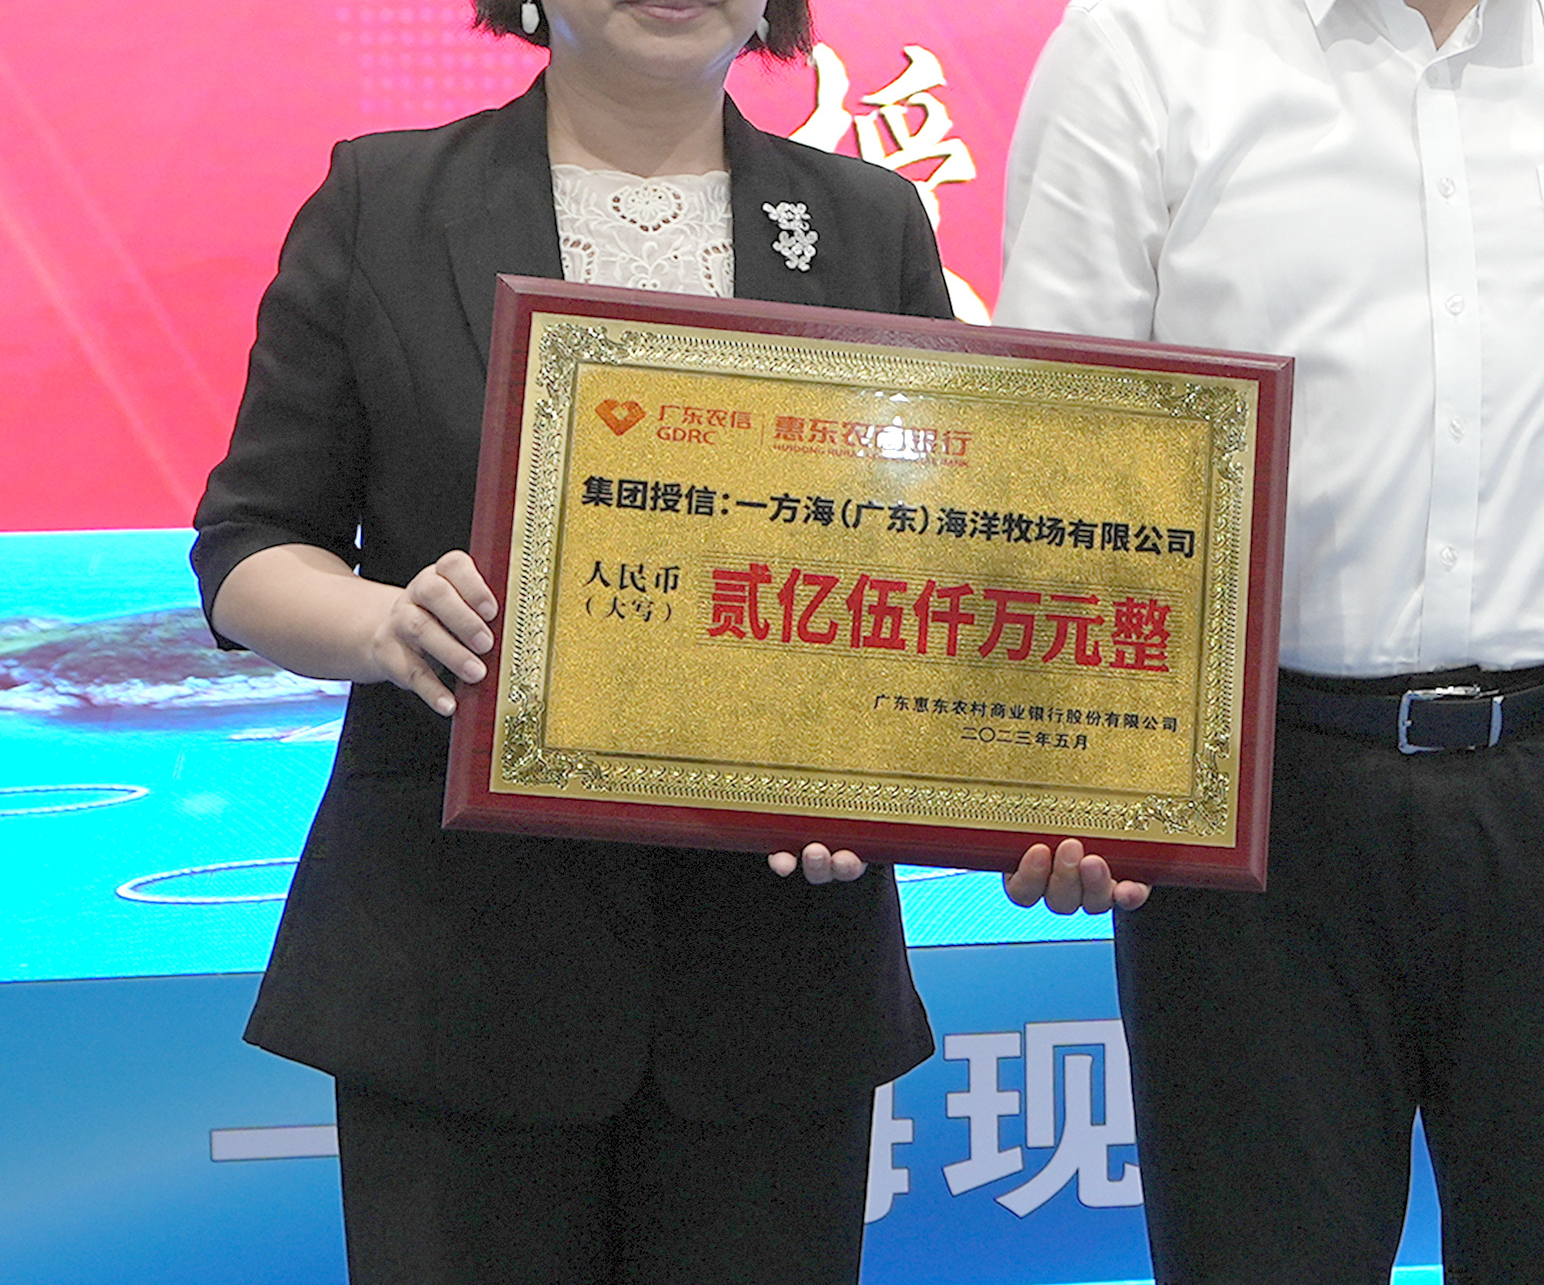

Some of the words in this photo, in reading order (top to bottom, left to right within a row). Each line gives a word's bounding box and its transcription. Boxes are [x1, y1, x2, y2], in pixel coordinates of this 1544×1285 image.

[656, 427, 719, 446] GDRC
[657, 406, 753, 434] 广东农信
[586, 562, 681, 595] 人民币
[707, 565, 1171, 674] 贰亿伍仟万元整
[874, 692, 1180, 734] 广东惠东农村商业银行股份有限公司
